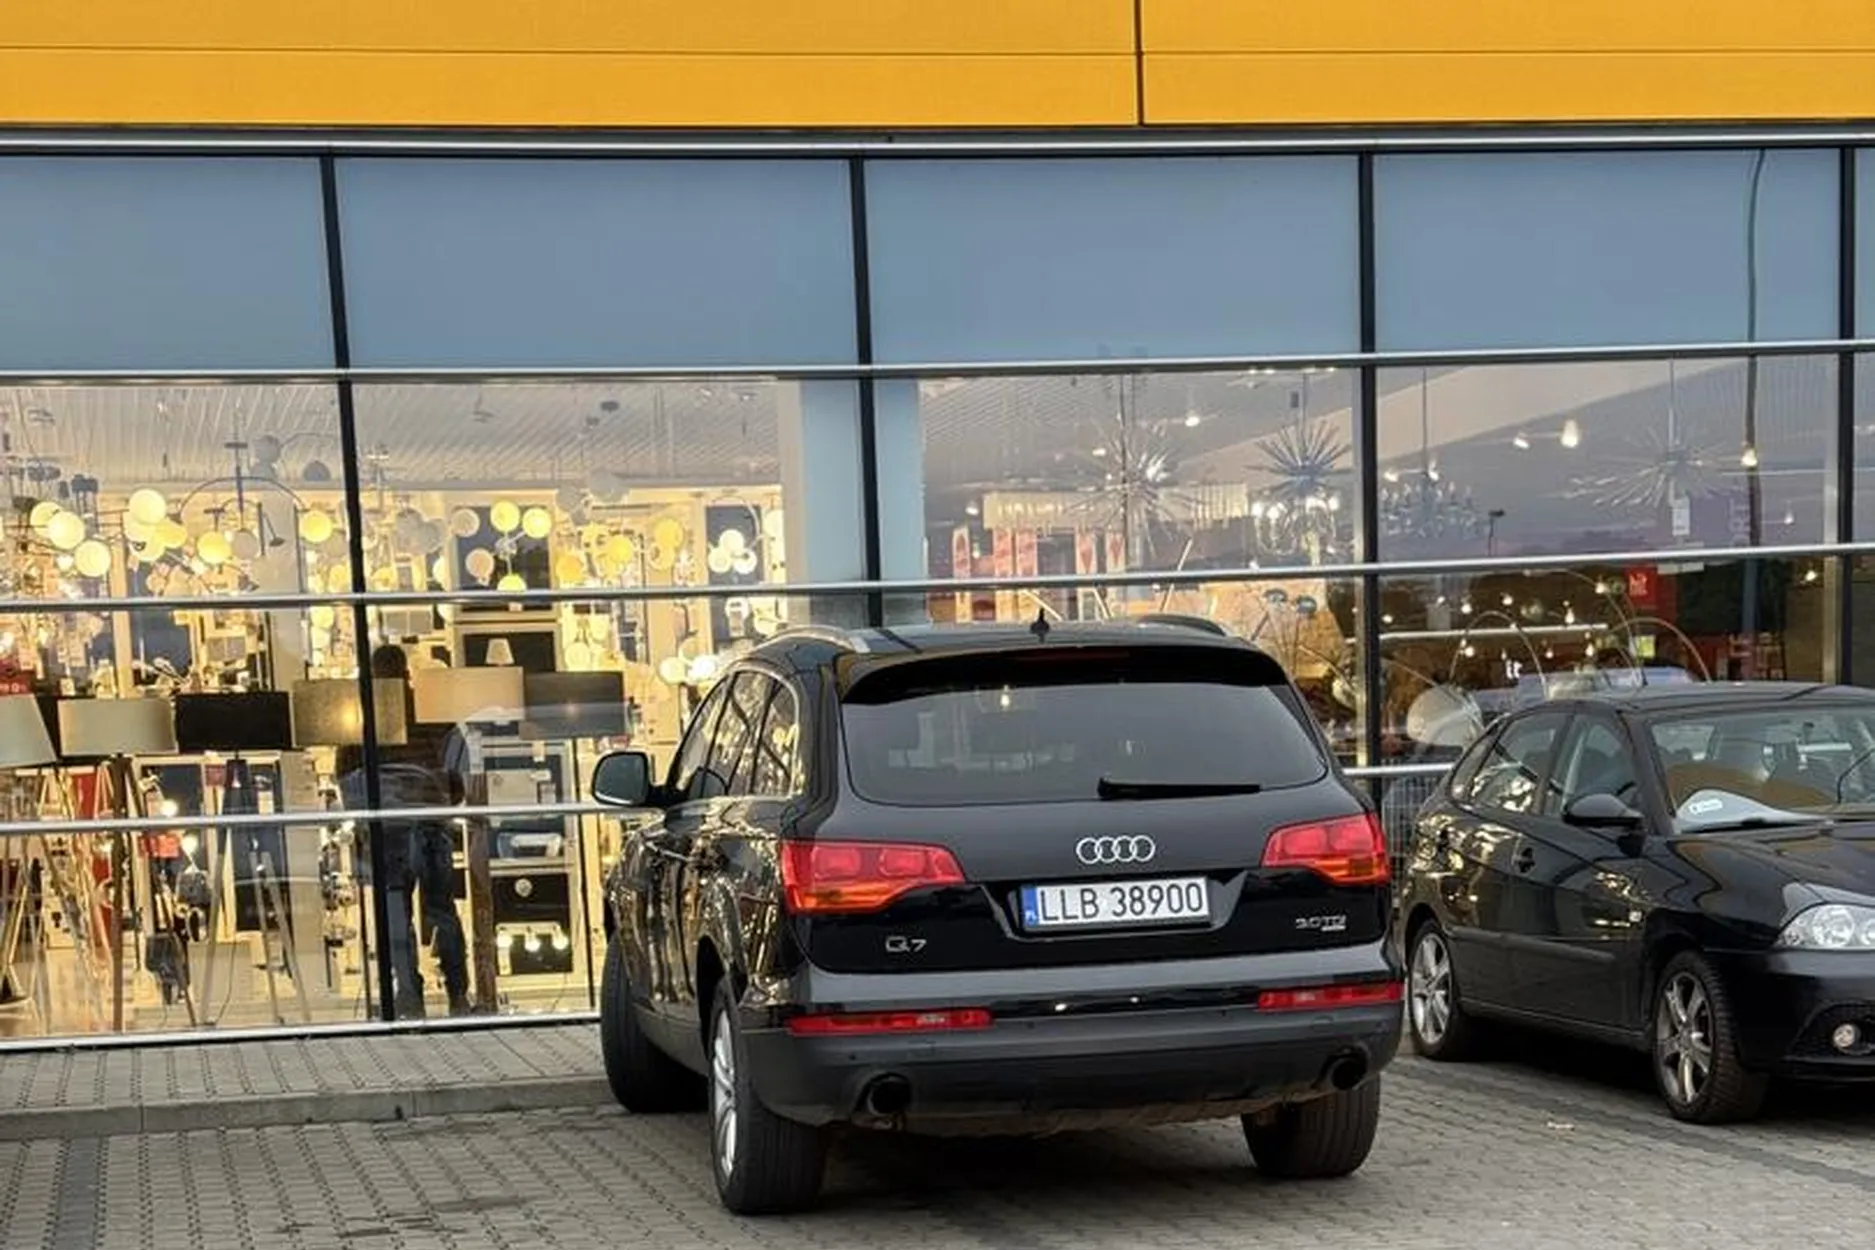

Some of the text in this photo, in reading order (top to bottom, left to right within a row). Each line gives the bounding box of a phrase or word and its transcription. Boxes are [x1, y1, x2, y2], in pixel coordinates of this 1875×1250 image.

[1040, 883, 1203, 921] LLB 38900
[885, 936, 927, 952] Q7
